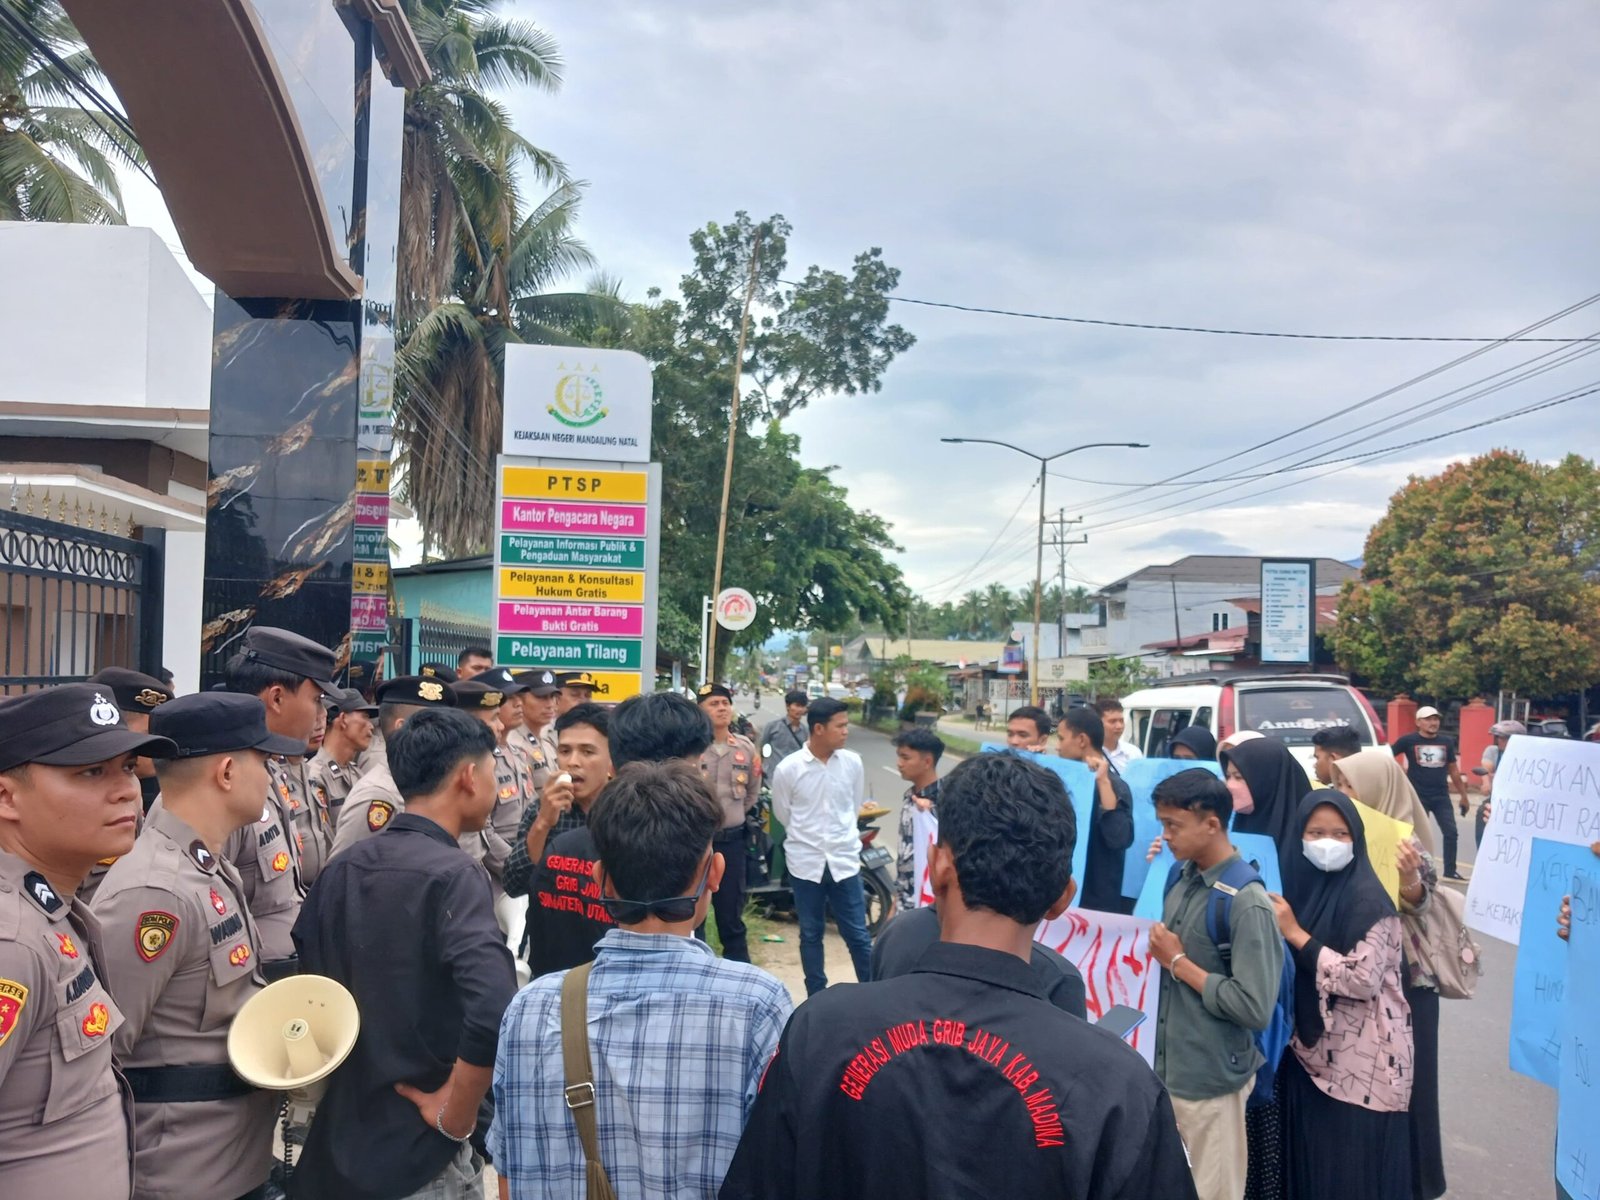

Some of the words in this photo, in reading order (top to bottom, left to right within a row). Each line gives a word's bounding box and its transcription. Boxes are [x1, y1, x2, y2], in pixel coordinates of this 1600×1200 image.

[514, 430, 550, 441] KEJAKSAAN
[552, 433, 575, 443] NEGERI
[576, 435, 617, 446] MANDAILING
[619, 437, 638, 447] NATAL
[548, 476, 601, 492] PTSP
[513, 506, 546, 523] Kantor
[547, 508, 598, 527] Pengacara
[601, 511, 634, 530] Negara
[509, 537, 554, 551] Pelayanan
[556, 539, 598, 550] Informasi
[600, 542, 627, 551] Publik
[629, 542, 636, 552] &
[520, 550, 569, 563] Pengaduan
[571, 552, 622, 564] Masyarakat
[510, 572, 564, 584] Pelayanan
[568, 574, 575, 583] &
[579, 574, 634, 586] Konsultasi
[536, 586, 572, 597] Hukum
[575, 588, 607, 598] Gratis
[513, 605, 563, 617] Pelayanan
[565, 606, 591, 616] Antar
[594, 607, 628, 619] Barang
[542, 620, 567, 631] Bukti
[570, 621, 599, 632] Gratis
[511, 641, 581, 660] Pelayanan
[585, 643, 627, 663] Tilang
[1495, 798, 1569, 831] MEMBUAT
[1488, 833, 1524, 867] JADI
[546, 855, 594, 876] GENERAS
[580, 882, 602, 900] JAY
[840, 1037, 892, 1101] GENERASI
[886, 1020, 929, 1055] MUDA
[932, 1019, 967, 1047] GRIB
[967, 1029, 1010, 1067] JAYA
[1024, 1088, 1065, 1148] MADINA
